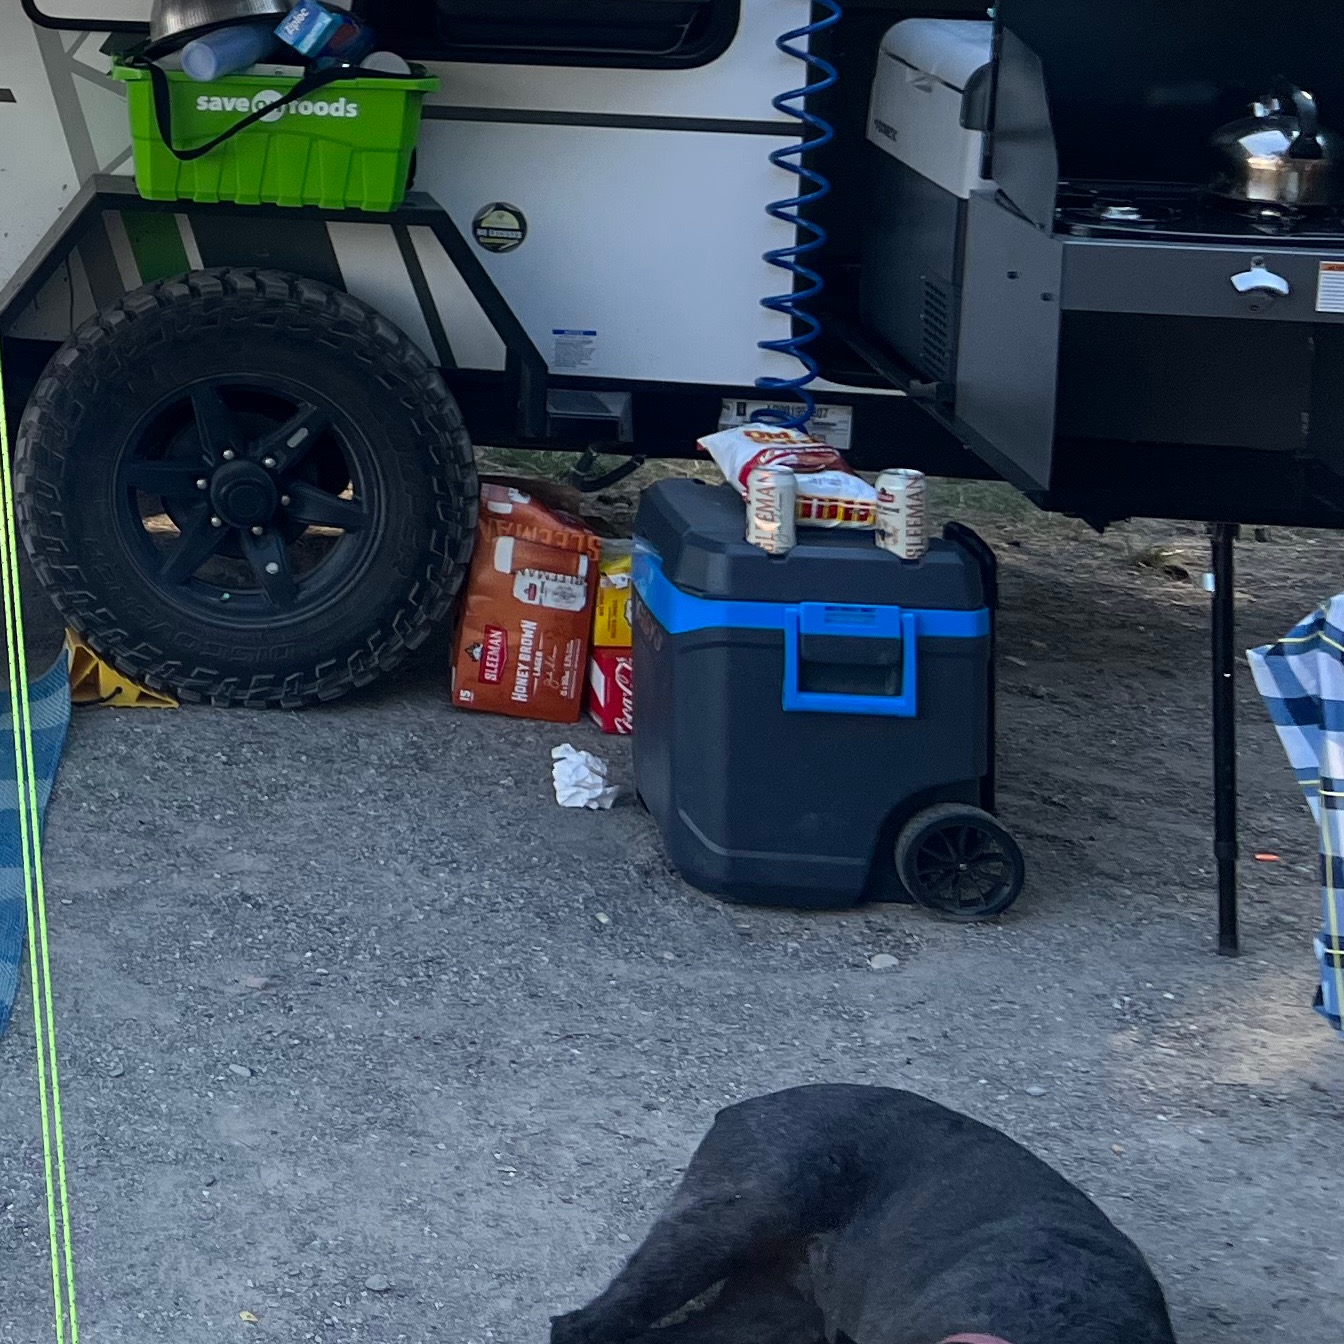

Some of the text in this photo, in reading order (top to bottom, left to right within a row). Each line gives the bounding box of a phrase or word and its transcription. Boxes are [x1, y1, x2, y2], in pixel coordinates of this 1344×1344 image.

[284, 7, 309, 35] Ziploc
[196, 95, 250, 112] save
[288, 97, 358, 117] foods
[905, 476, 925, 558] SLEEMAN
[479, 518, 600, 561] SLEEMAN
[484, 629, 503, 682] SLEEMAN
[511, 619, 538, 703] HONEY BROWN
[532, 650, 544, 677] LAGER
[460, 689, 471, 701] 15
[614, 656, 633, 735] Coca-Cl
